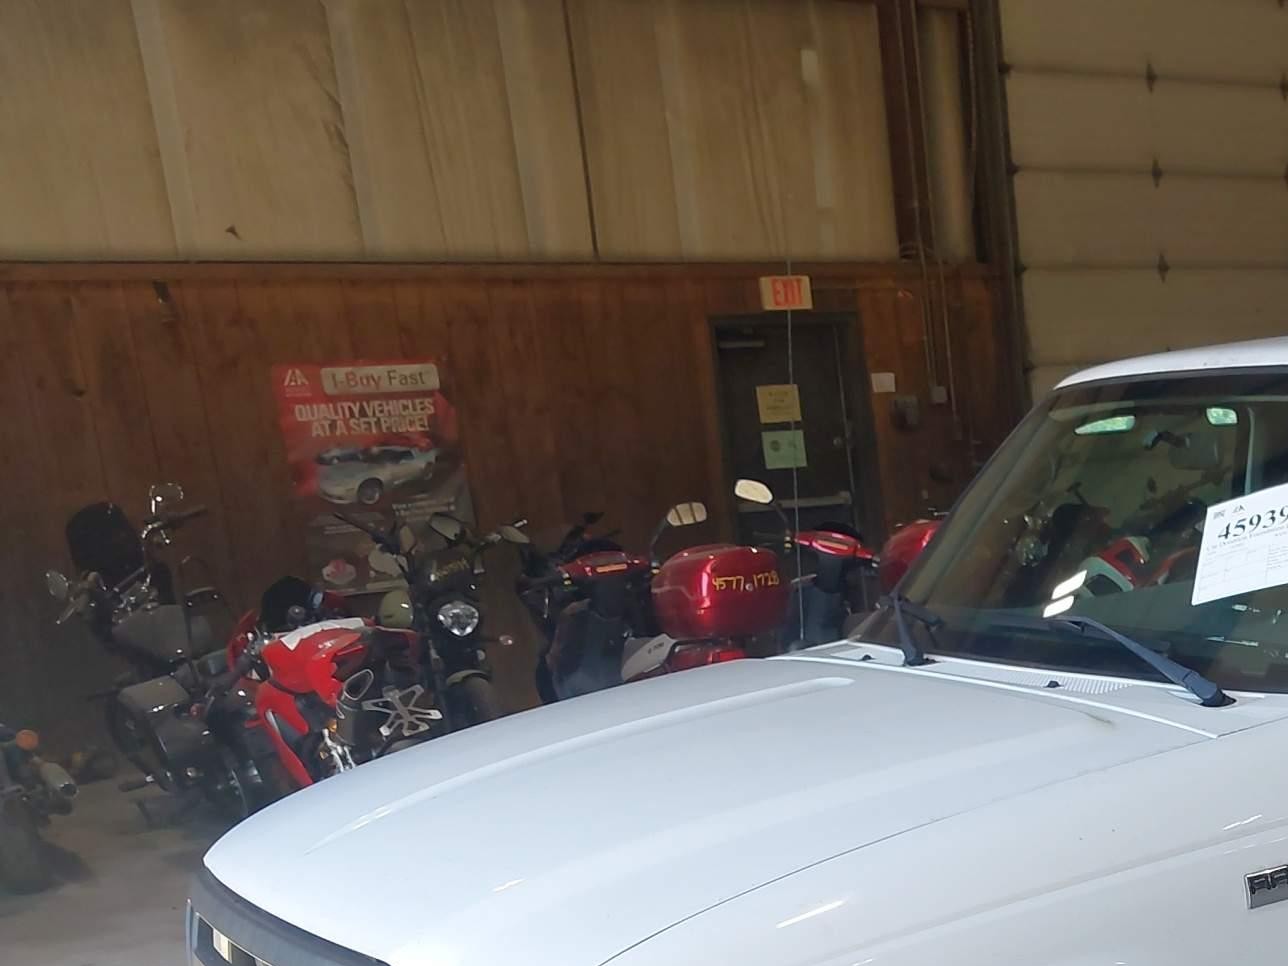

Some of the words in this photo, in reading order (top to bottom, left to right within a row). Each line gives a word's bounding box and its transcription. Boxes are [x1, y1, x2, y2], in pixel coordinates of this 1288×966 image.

[332, 371, 381, 389] I-Buy
[387, 370, 426, 387] Fast
[295, 400, 363, 421] QUALITY
[362, 398, 435, 417] VEHICLES
[312, 419, 332, 437] AT
[335, 419, 348, 436] A
[350, 417, 379, 434] SET
[381, 415, 430, 433] PRICE!
[711, 576, 745, 592] 4577
